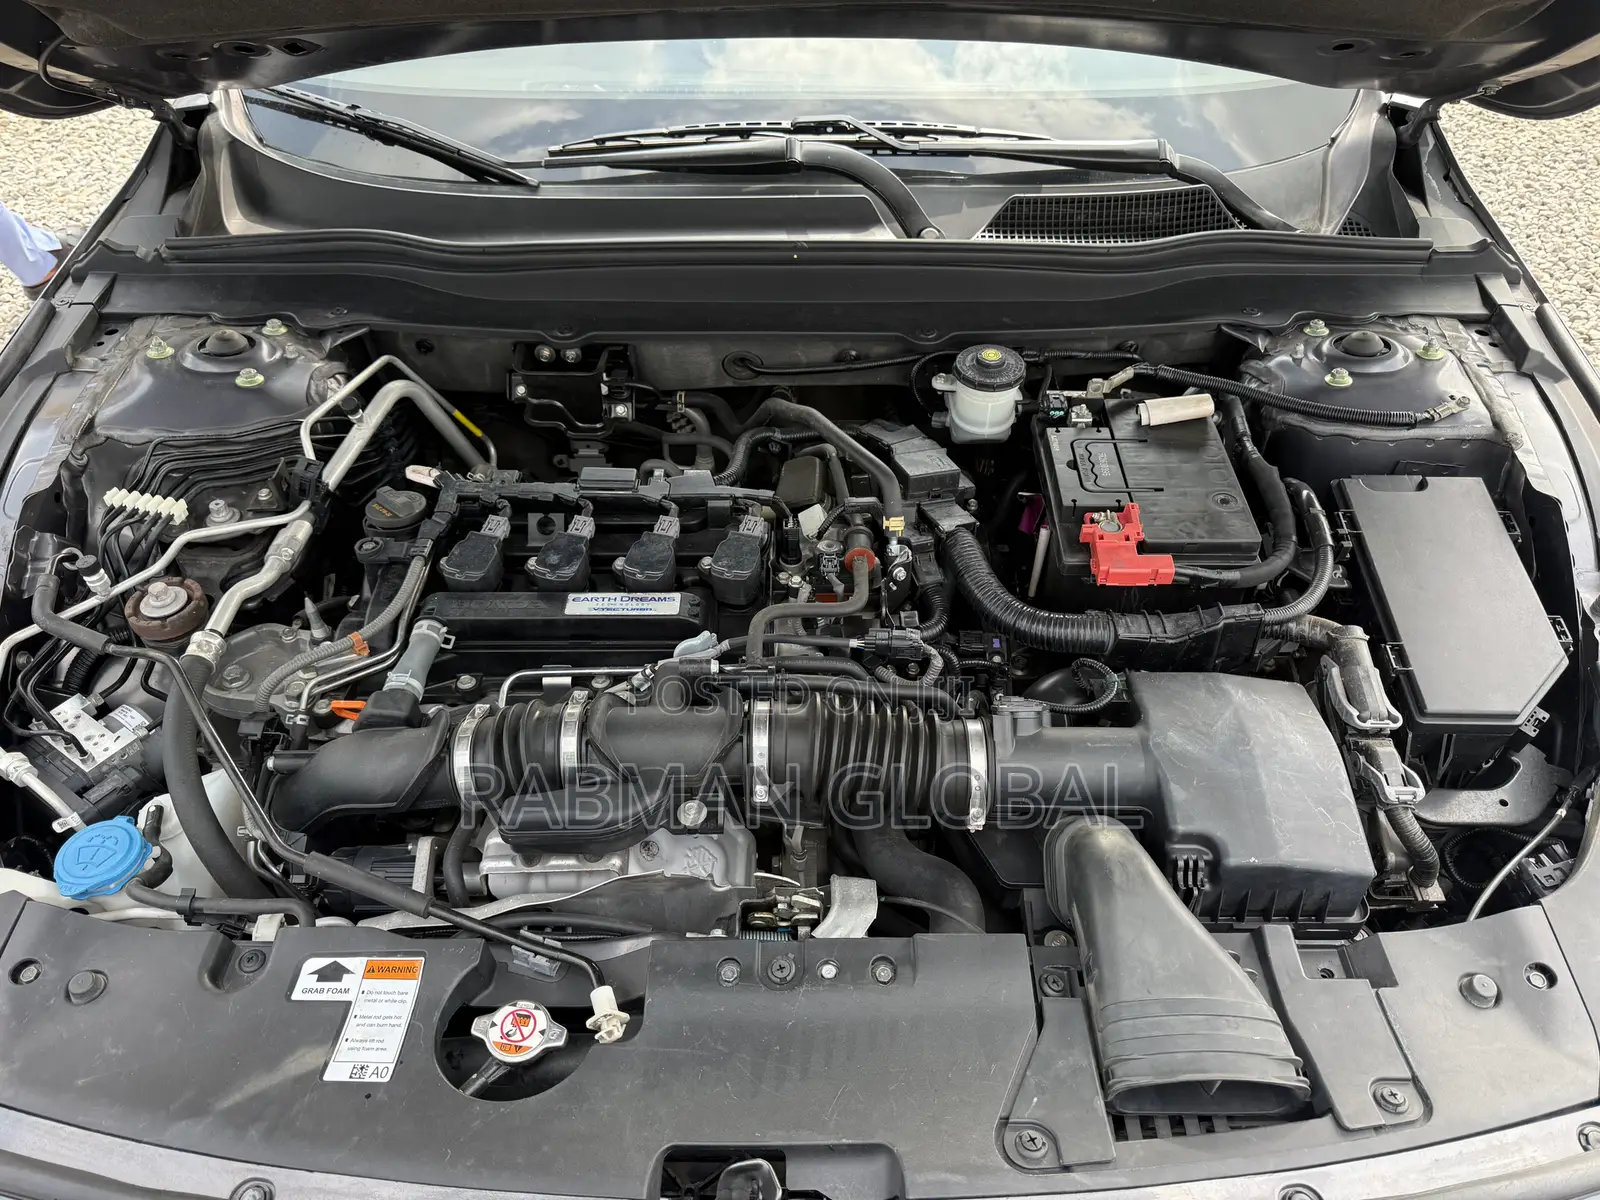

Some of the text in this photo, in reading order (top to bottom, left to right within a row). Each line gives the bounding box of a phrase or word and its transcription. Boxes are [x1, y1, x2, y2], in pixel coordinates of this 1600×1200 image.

[377, 966, 419, 974] WARNING
[301, 987, 350, 995] GRAB FOAM
[369, 1066, 389, 1079] A0
